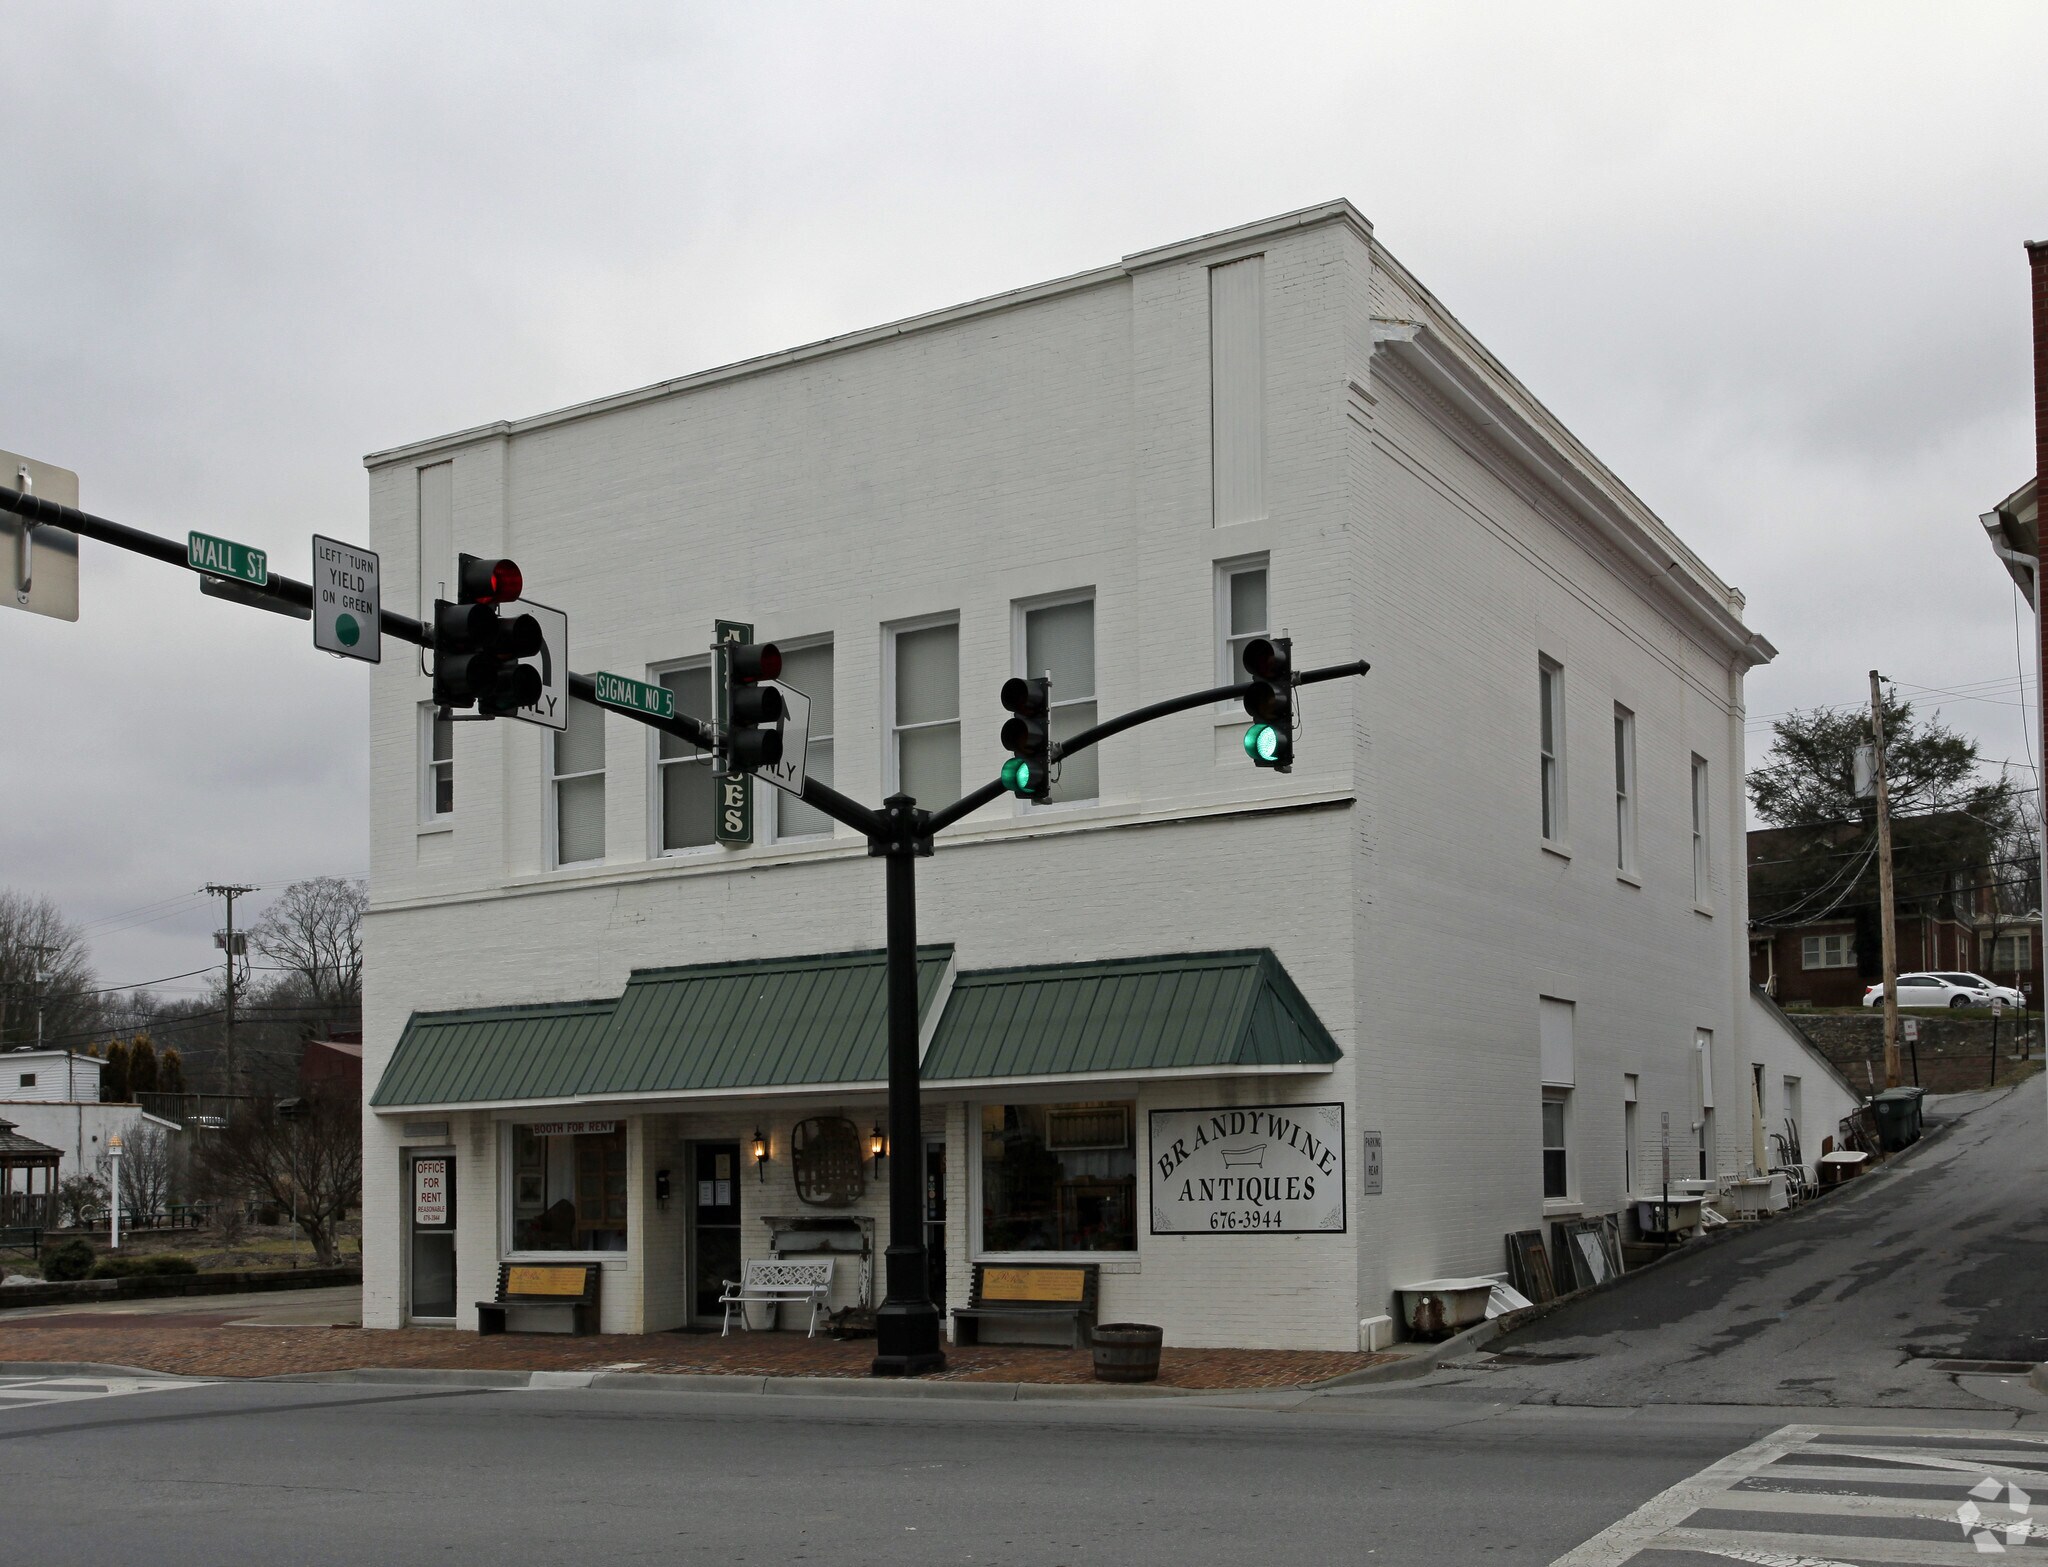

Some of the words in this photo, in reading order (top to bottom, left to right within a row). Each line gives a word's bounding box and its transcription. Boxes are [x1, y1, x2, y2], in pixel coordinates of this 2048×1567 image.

[192, 535, 236, 573] WALL
[247, 551, 265, 580] ST
[319, 546, 342, 564] LEFT
[349, 555, 374, 574] TURN
[329, 567, 364, 593] YIELD
[322, 589, 335, 604] ON
[342, 595, 373, 615] GREEN
[598, 675, 638, 706] SIGNAL
[645, 687, 659, 711] NO
[665, 693, 673, 715] 5
[534, 1122, 563, 1134] BOOTH
[567, 1121, 584, 1133] FOR
[588, 1120, 614, 1132] RENT
[1157, 1110, 1337, 1182] BRANDYWINE
[417, 1162, 445, 1174] OFFICE
[423, 1177, 440, 1188] FOR
[1178, 1175, 1316, 1207] ANTIQUES
[417, 1205, 445, 1213] REASONABLE
[421, 1192, 442, 1203] RENT
[1209, 1210, 1283, 1230] 676-3944
